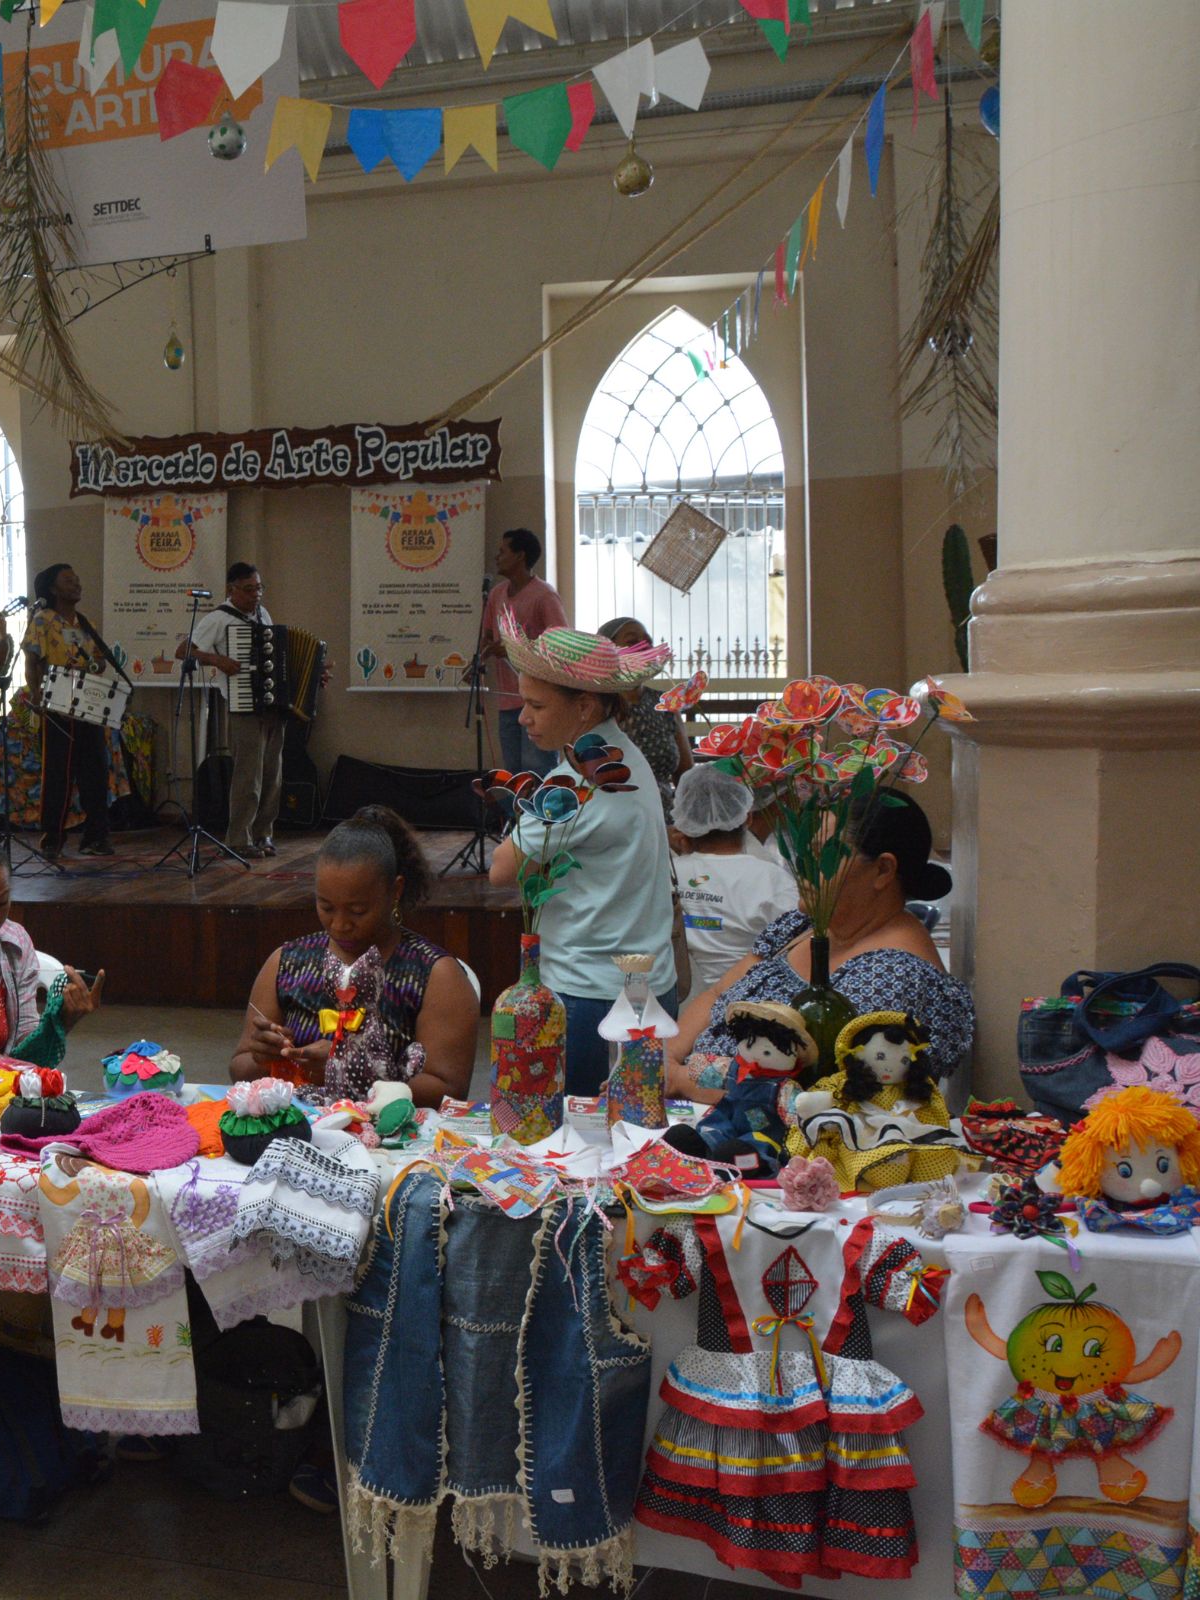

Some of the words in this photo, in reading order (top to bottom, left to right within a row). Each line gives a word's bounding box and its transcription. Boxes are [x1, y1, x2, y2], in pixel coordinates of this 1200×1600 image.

[63, 86, 159, 137] ART
[93, 197, 141, 216] SETTDEC
[76, 442, 217, 492] Mercado
[221, 440, 261, 482] de
[264, 429, 350, 479] Arte
[355, 425, 492, 481] Popular
[150, 538, 182, 547] FEIRA
[401, 536, 436, 546] FEIRA
